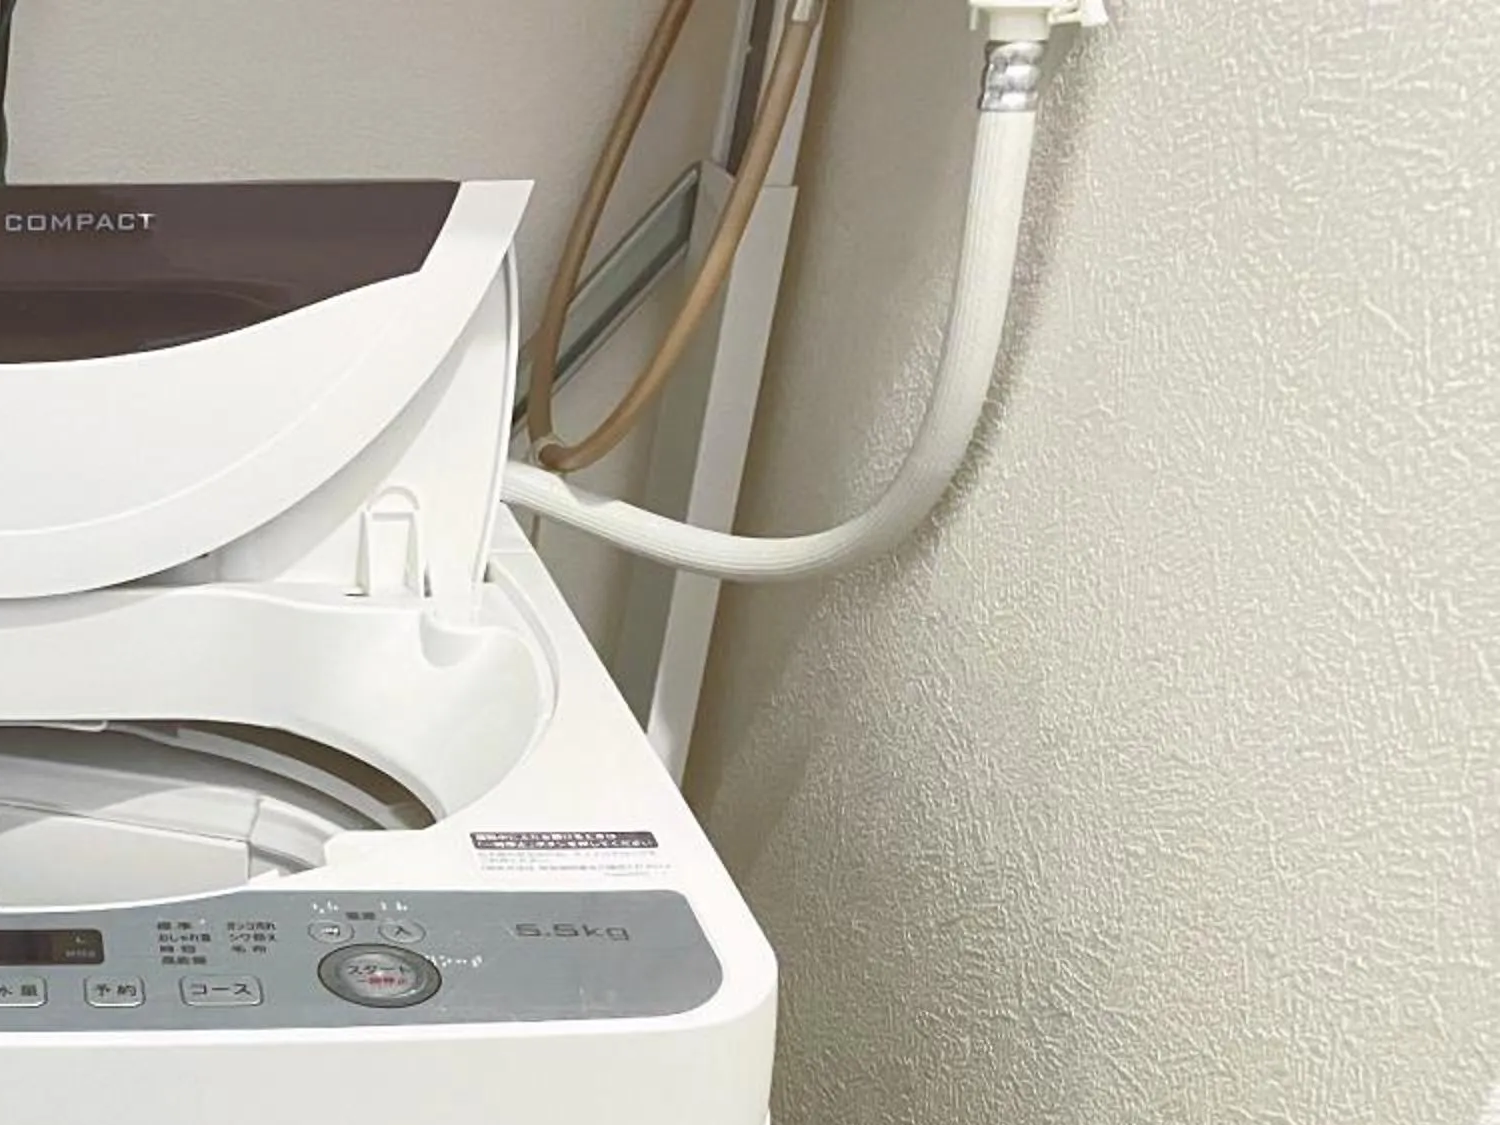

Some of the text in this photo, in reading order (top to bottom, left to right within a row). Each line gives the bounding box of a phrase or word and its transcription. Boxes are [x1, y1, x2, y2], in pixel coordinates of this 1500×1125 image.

[5, 213, 156, 231] COMPACT
[515, 923, 630, 941] 5.5kg
[96, 983, 137, 997] 予約
[190, 982, 253, 996] コース
